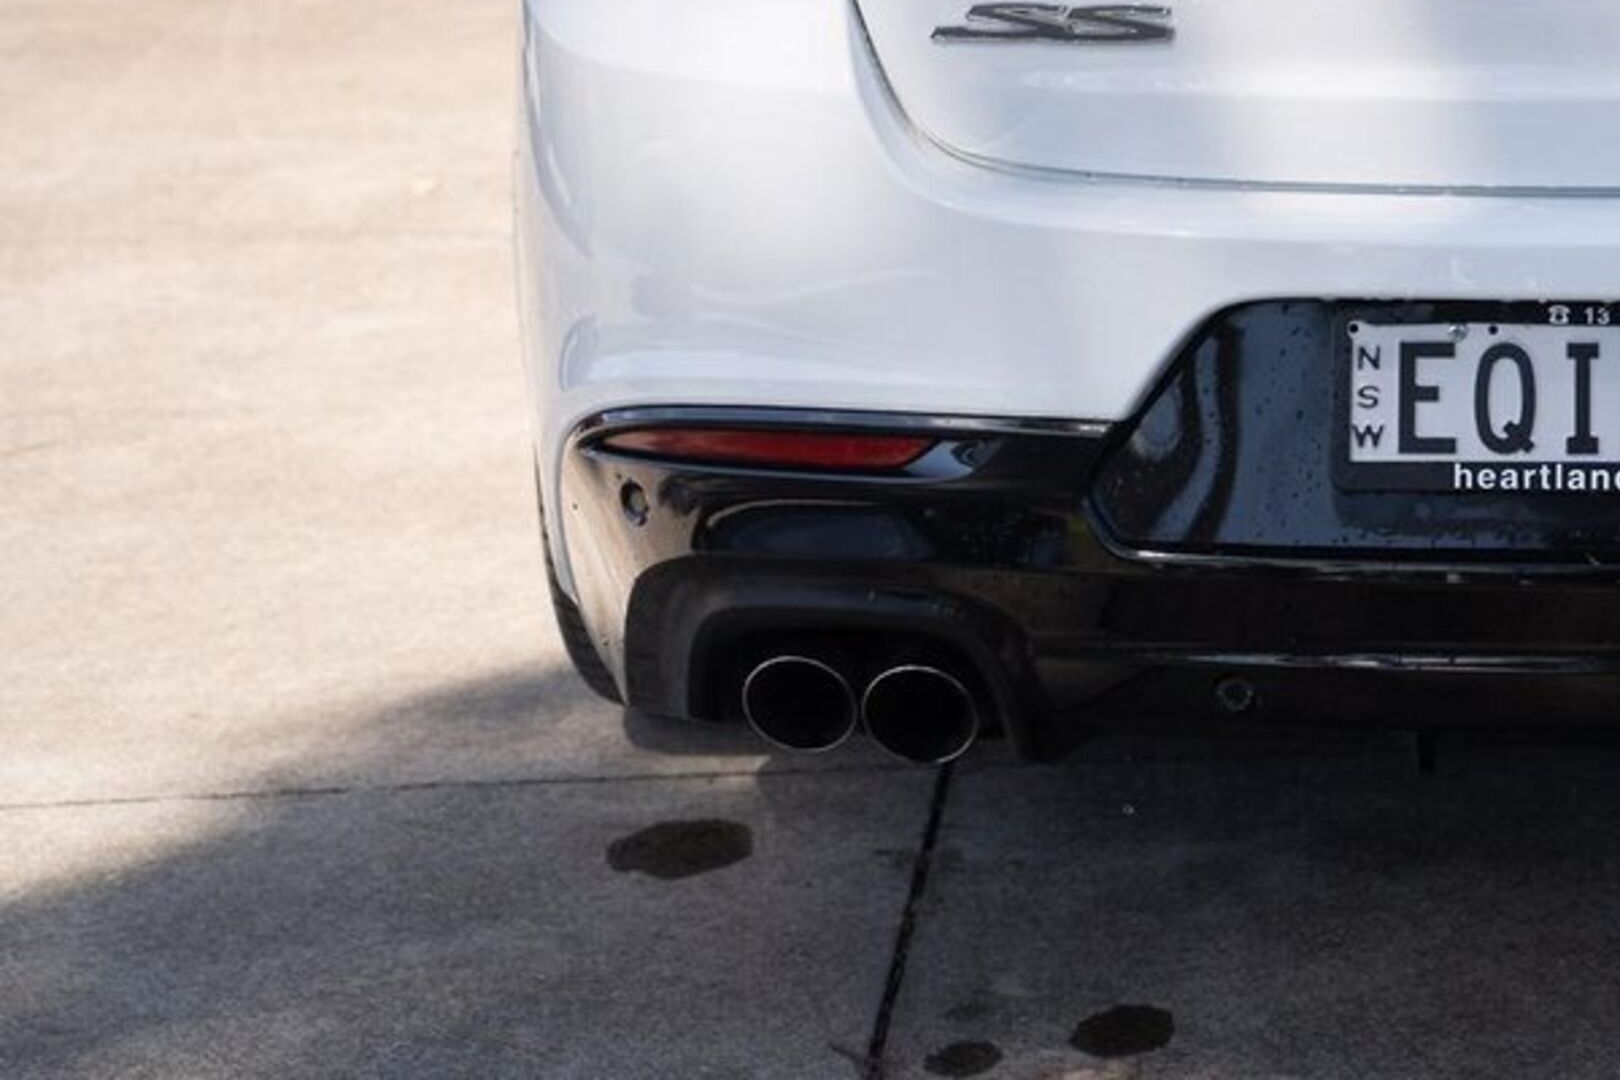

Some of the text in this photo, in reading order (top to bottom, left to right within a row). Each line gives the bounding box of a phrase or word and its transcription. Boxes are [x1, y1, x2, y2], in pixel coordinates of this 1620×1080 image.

[931, 2, 1174, 42] SS
[1584, 307, 1609, 325] 13
[1354, 344, 1384, 448] NSW
